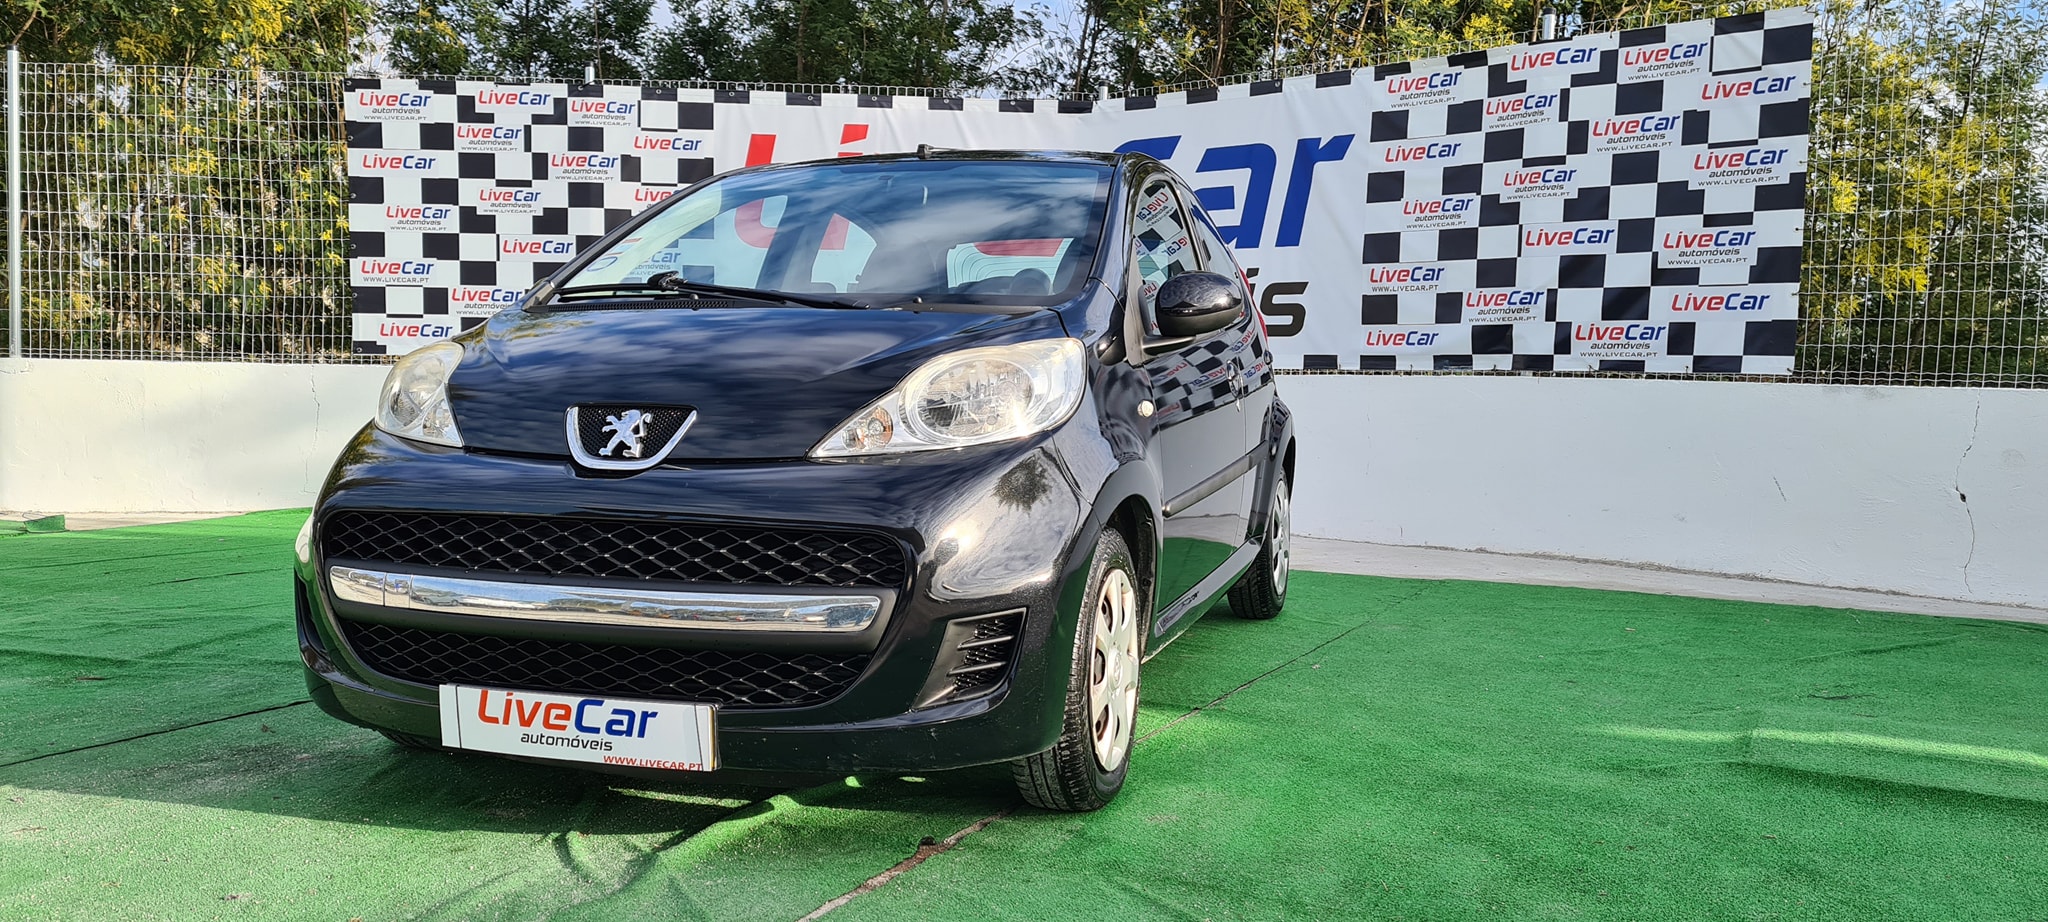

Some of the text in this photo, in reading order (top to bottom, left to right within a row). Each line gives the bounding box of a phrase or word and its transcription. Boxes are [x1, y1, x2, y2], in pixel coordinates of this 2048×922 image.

[1510, 48, 1597, 71] LiveCar
[1624, 42, 1708, 66] LiveCar
[1637, 60, 1694, 72] automóveis
[1388, 72, 1462, 94] LiveCar
[1702, 76, 1796, 100] LiveCar
[360, 92, 431, 107] LiveCar
[478, 90, 551, 106] LiveCar
[1400, 89, 1450, 101] automóveis
[571, 100, 635, 114] LiveCar
[1486, 94, 1558, 116] LiveCar
[1497, 109, 1545, 122] automóveis
[457, 125, 522, 139] LiveCar
[1592, 116, 1680, 137] LiveCar
[634, 136, 702, 150] LiveCar
[1607, 133, 1666, 145] automóveis
[1385, 143, 1462, 162] LiveCar
[1694, 149, 1788, 170] LiveCar
[362, 154, 436, 170] LiveCar
[552, 154, 618, 168] LiveCar
[1504, 169, 1577, 186] LiveCar
[1709, 167, 1772, 178] automóveis
[480, 189, 541, 201] LiveCar
[1514, 184, 1564, 193] automóveis
[386, 206, 451, 220] LiveCar
[1404, 198, 1474, 214] LiveCar
[1414, 213, 1462, 222] automóveis
[1525, 228, 1614, 246] LiveCar
[1664, 230, 1756, 249] LiveCar
[502, 239, 573, 254] LiveCar
[1678, 248, 1740, 258] automóveis
[361, 260, 434, 274] LiveCar
[1370, 266, 1444, 283] LiveCar
[452, 288, 523, 302] LiveCar
[1372, 284, 1438, 292] WWW.LIVECAR.PT
[1466, 290, 1544, 308] LiveCar
[1672, 293, 1770, 312] LiveCar
[1478, 306, 1530, 316] automóveis
[380, 322, 452, 338] LiveCar
[1366, 330, 1438, 346] LiveCar
[1575, 324, 1667, 341] LiveCar
[1590, 342, 1650, 350] automóveis
[478, 689, 658, 738] LiveCar
[520, 732, 613, 752] automóveis
[603, 755, 703, 772] WWW.LIVECAR.PT
